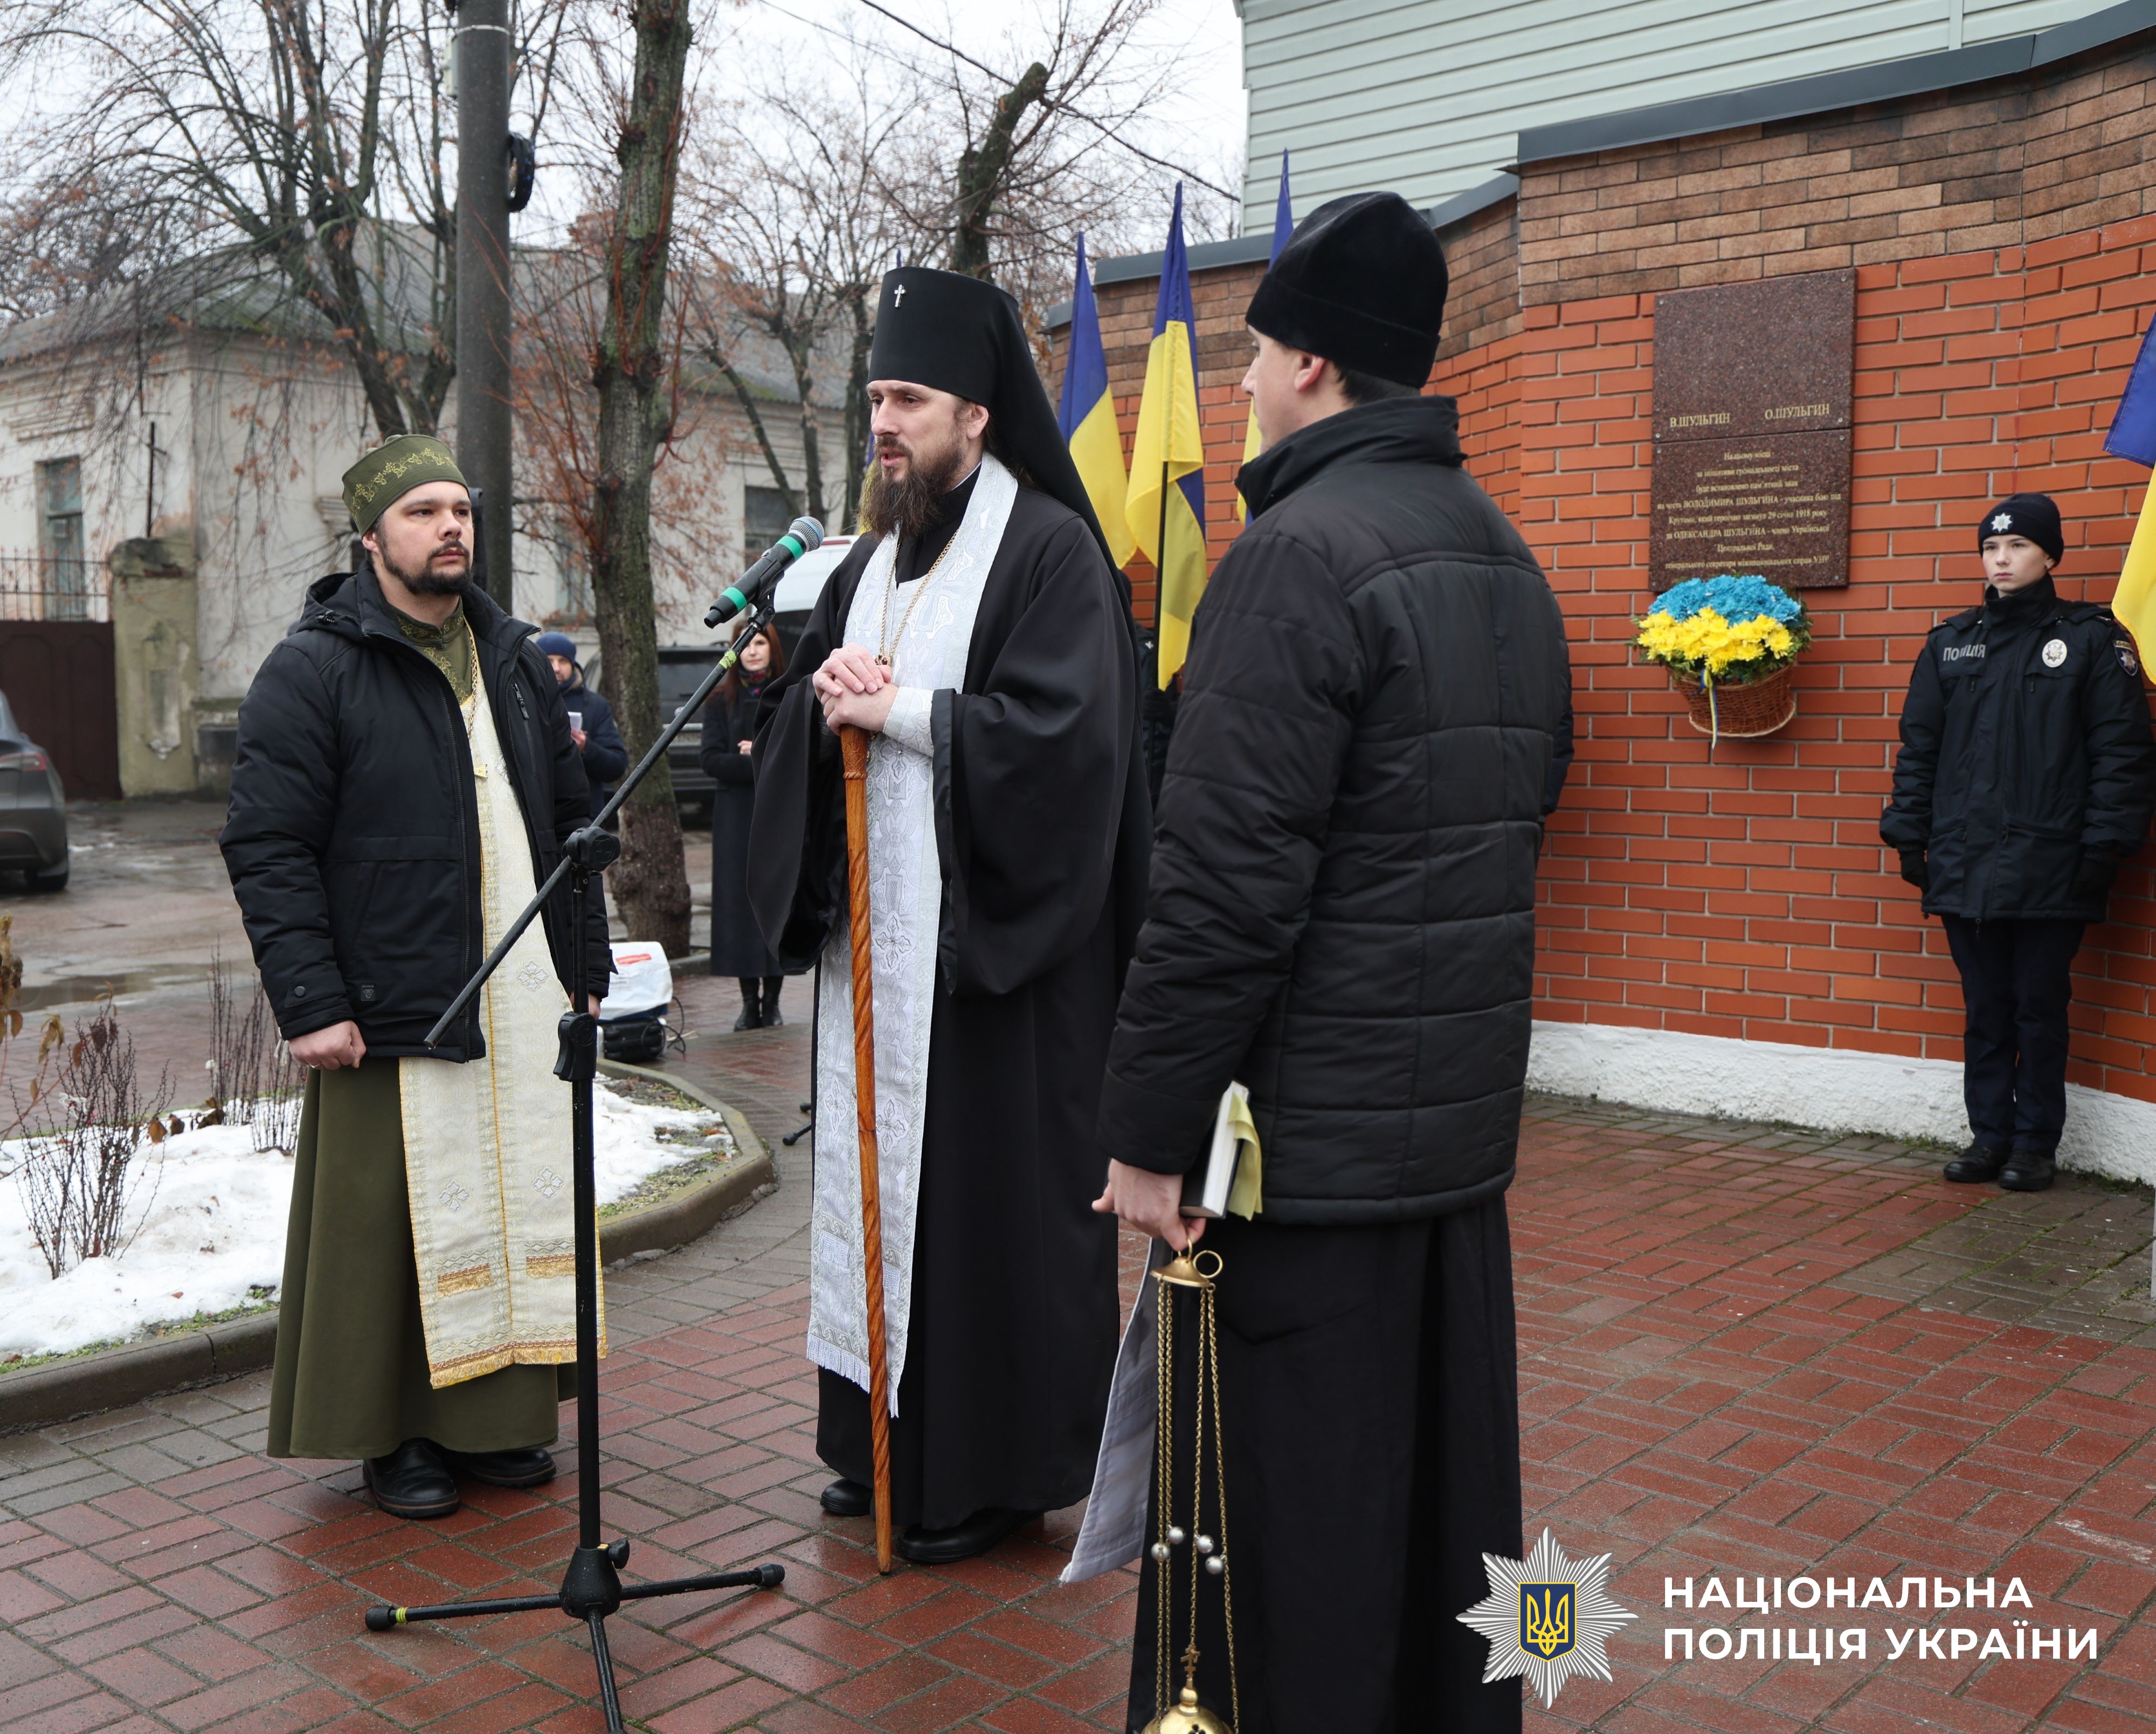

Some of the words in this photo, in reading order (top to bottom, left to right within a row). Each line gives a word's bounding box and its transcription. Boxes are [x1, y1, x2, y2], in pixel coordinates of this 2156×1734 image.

[1764, 404, 1830, 420] О.ШУЛЬГИН
[1669, 412, 1730, 427] В.ШУЛЬГИН
[1696, 485, 1709, 494] буде
[1683, 498, 1734, 509] ВОЛОДИМИРА
[1736, 495, 1778, 506] ШУЛЬГИНА
[1815, 493, 1829, 501] бою
[1796, 509, 1811, 517] 1918
[1812, 509, 1827, 518] року
[1674, 529, 1722, 538] ОЛЕКСАНДРА
[1724, 527, 1765, 537] ШУЛЬГИНА
[1791, 524, 1830, 535] Української
[1717, 543, 1756, 552] Центральної
[1813, 555, 1829, 563] УНР
